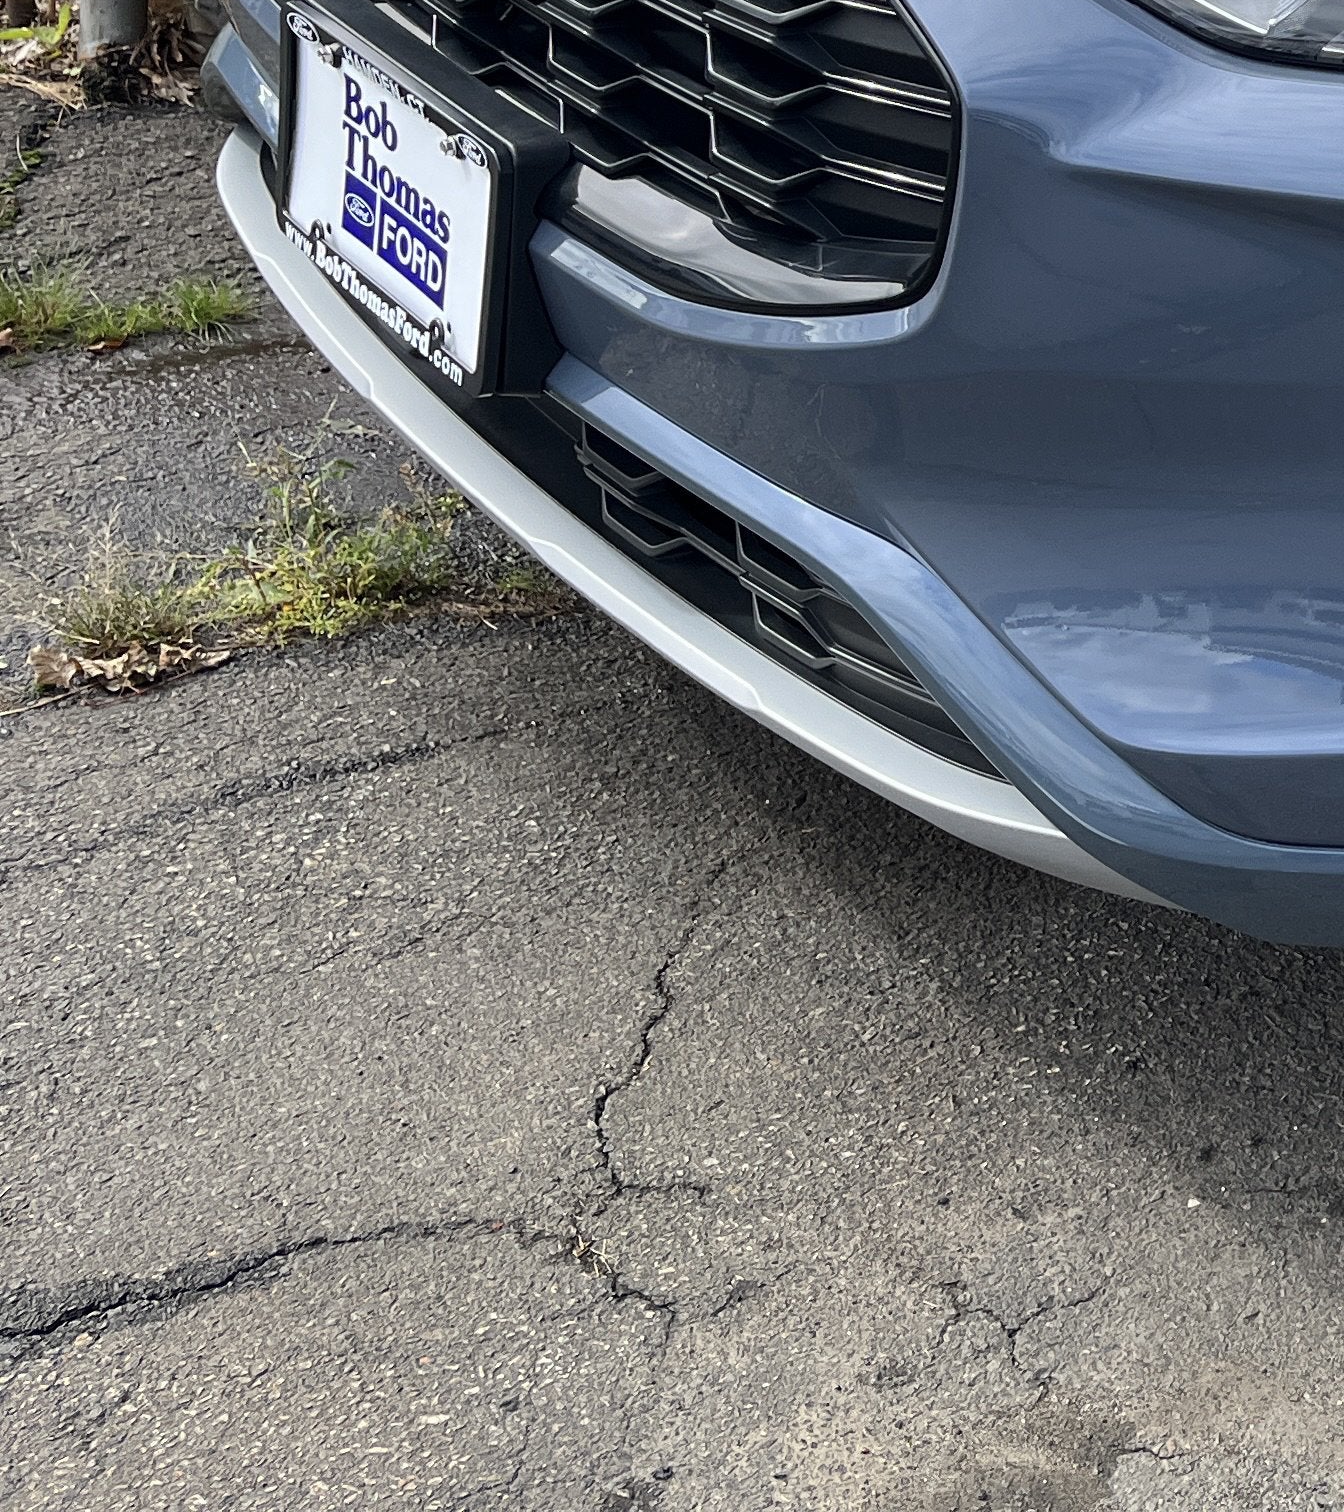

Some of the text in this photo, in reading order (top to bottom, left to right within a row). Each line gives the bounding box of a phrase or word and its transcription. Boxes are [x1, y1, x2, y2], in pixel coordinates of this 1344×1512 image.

[343, 73, 398, 152] Bob
[342, 119, 451, 245] Thomas
[350, 197, 371, 222] Ford
[381, 213, 443, 292] FORD
[285, 221, 464, 387] www.BobThomasFord.com
